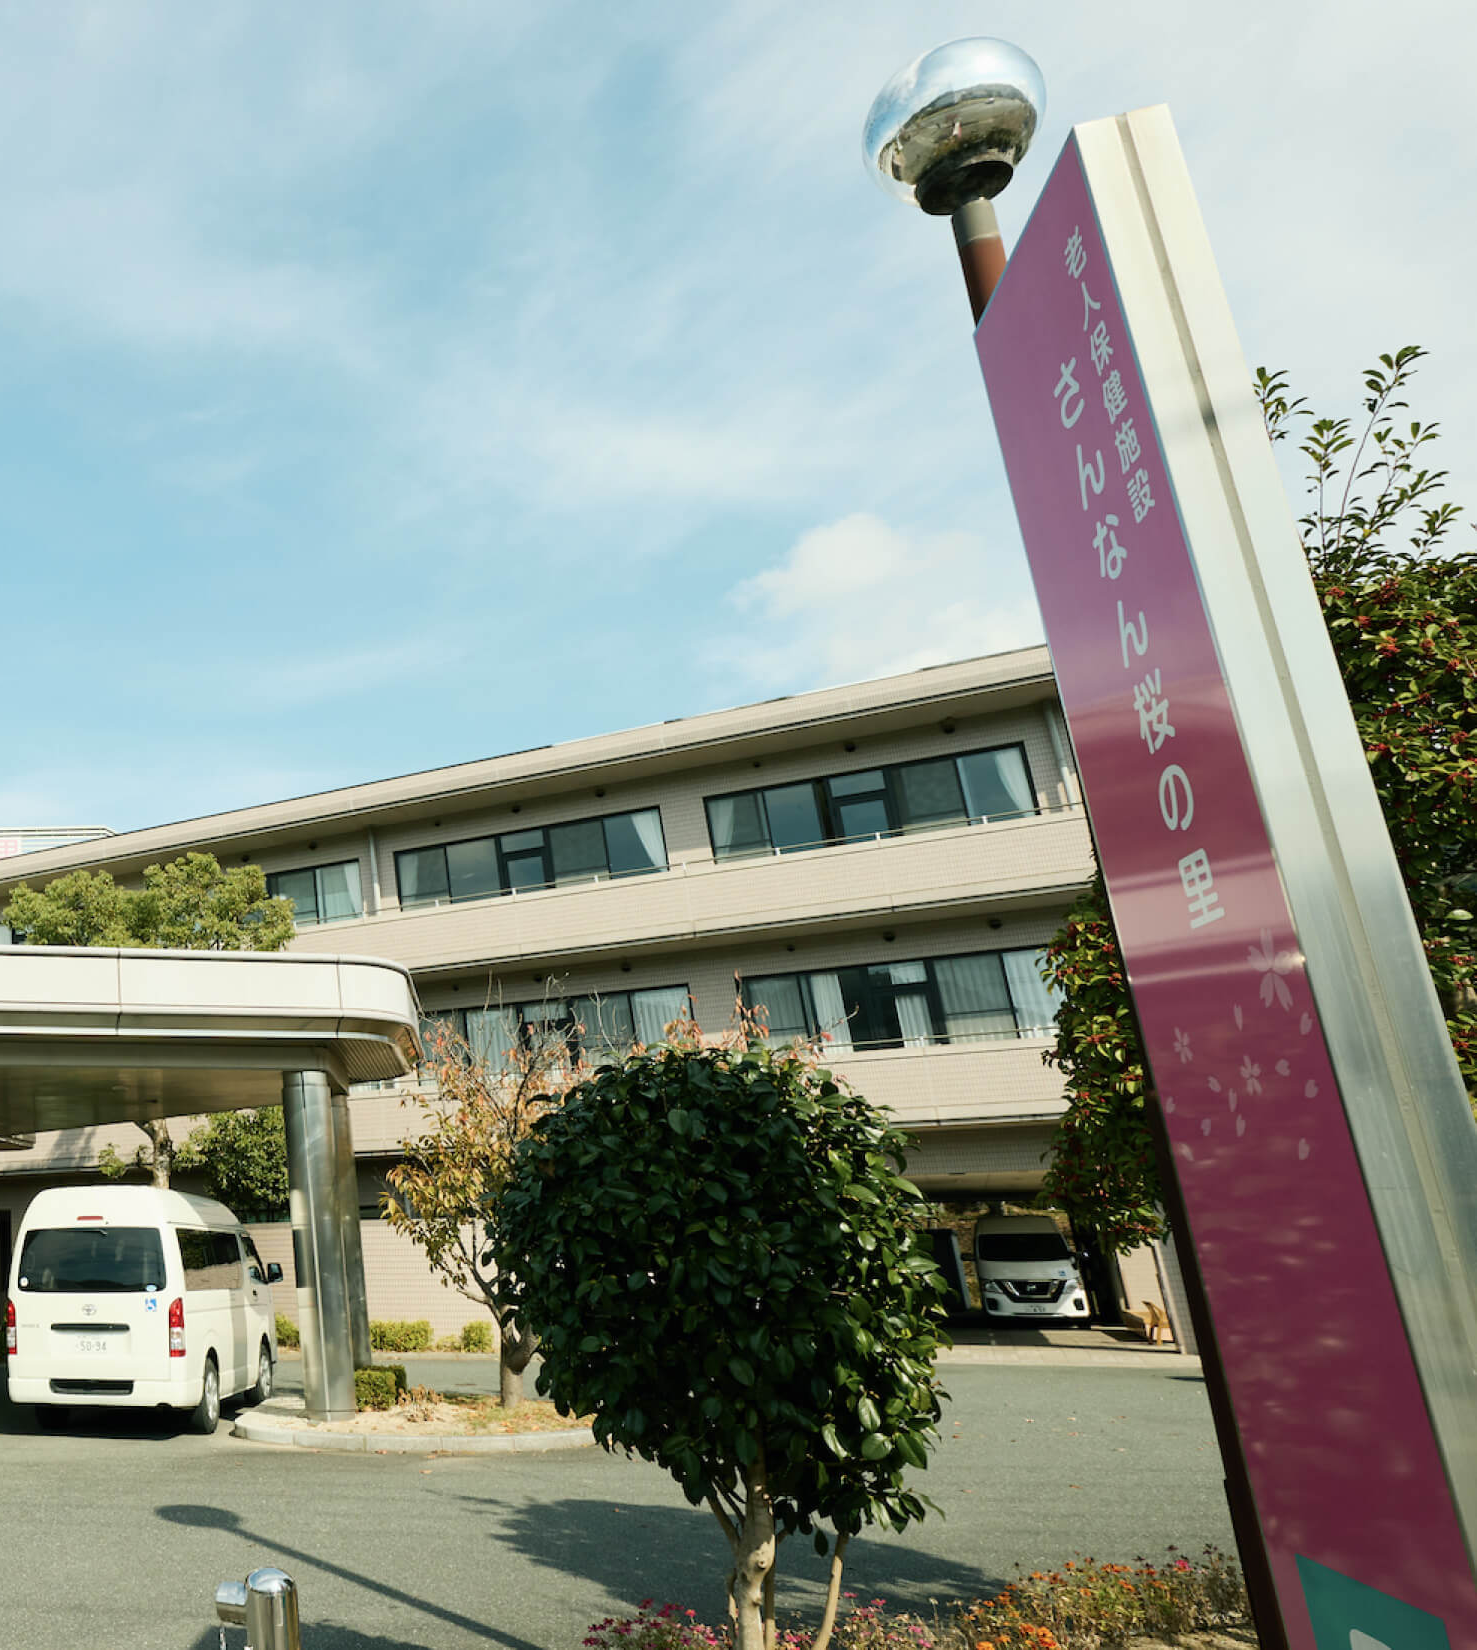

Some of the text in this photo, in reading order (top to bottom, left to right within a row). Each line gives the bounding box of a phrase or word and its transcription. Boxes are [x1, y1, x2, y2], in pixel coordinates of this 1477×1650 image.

[1064, 225, 1156, 524] 老人保健施設
[1053, 356, 1225, 931] さんなん桜の里
